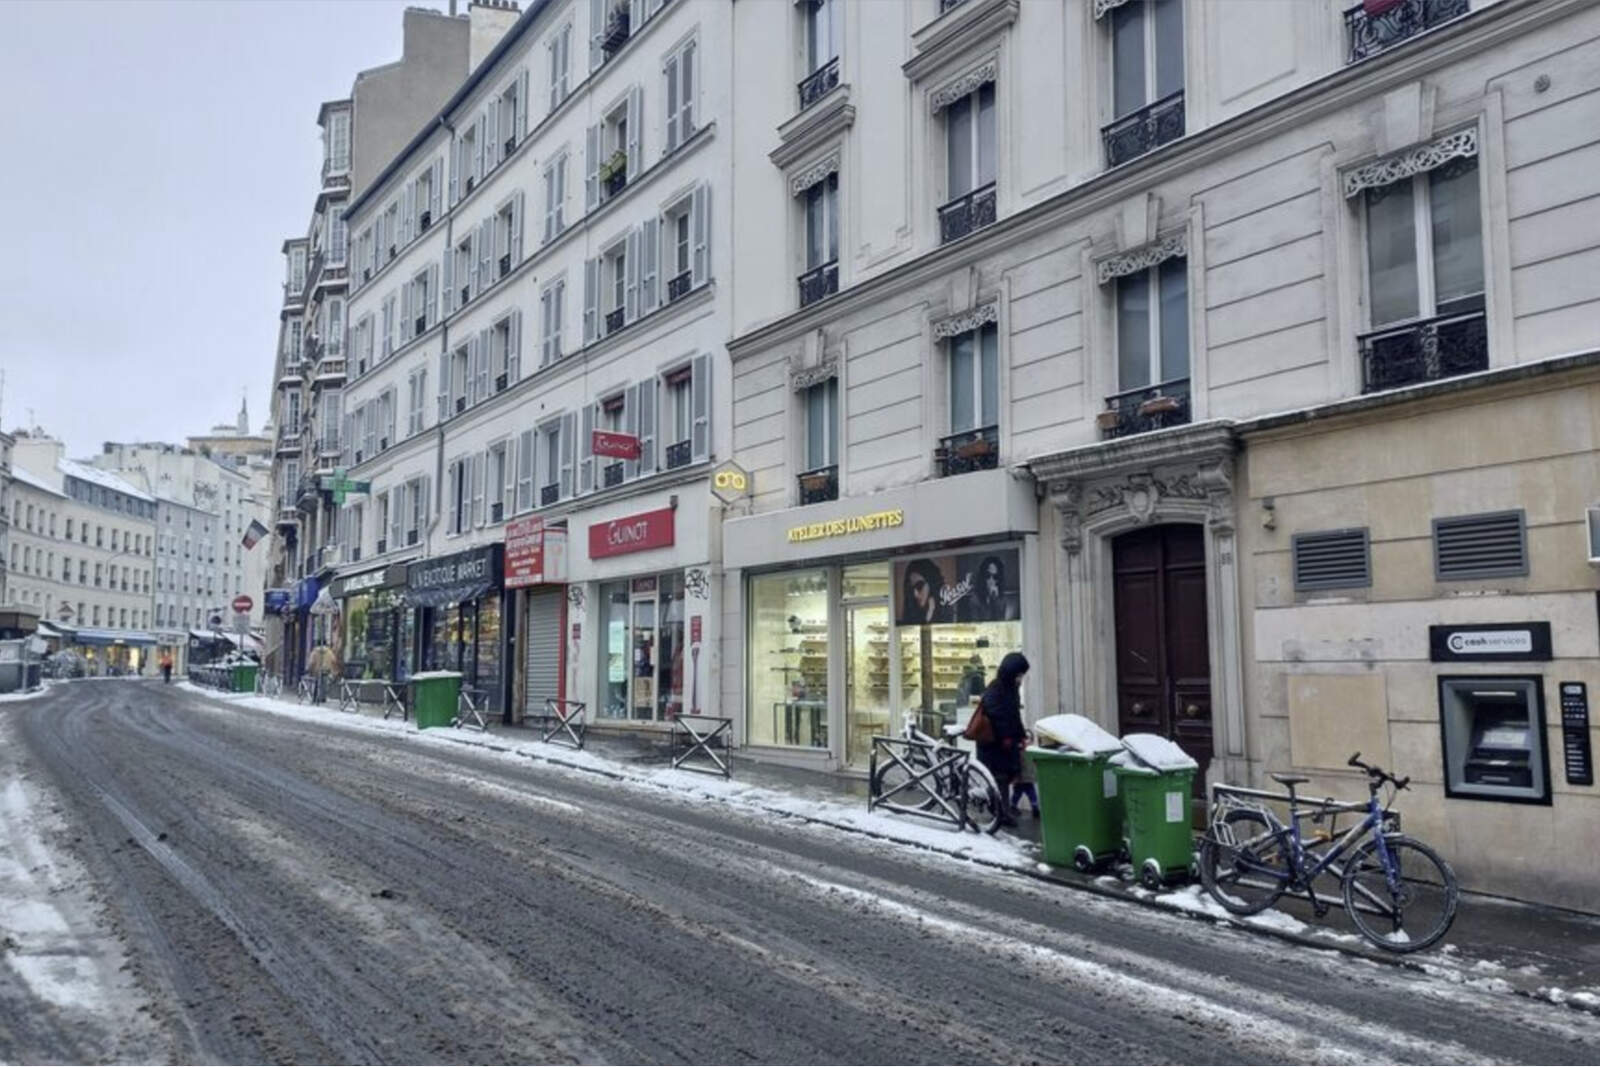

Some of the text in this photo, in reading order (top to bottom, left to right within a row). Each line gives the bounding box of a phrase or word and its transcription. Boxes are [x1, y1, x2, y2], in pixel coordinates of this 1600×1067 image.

[608, 521, 648, 545] GUINOT
[789, 511, 903, 541] ATELIER DES LUNETTES
[458, 559, 486, 580] MARKET
